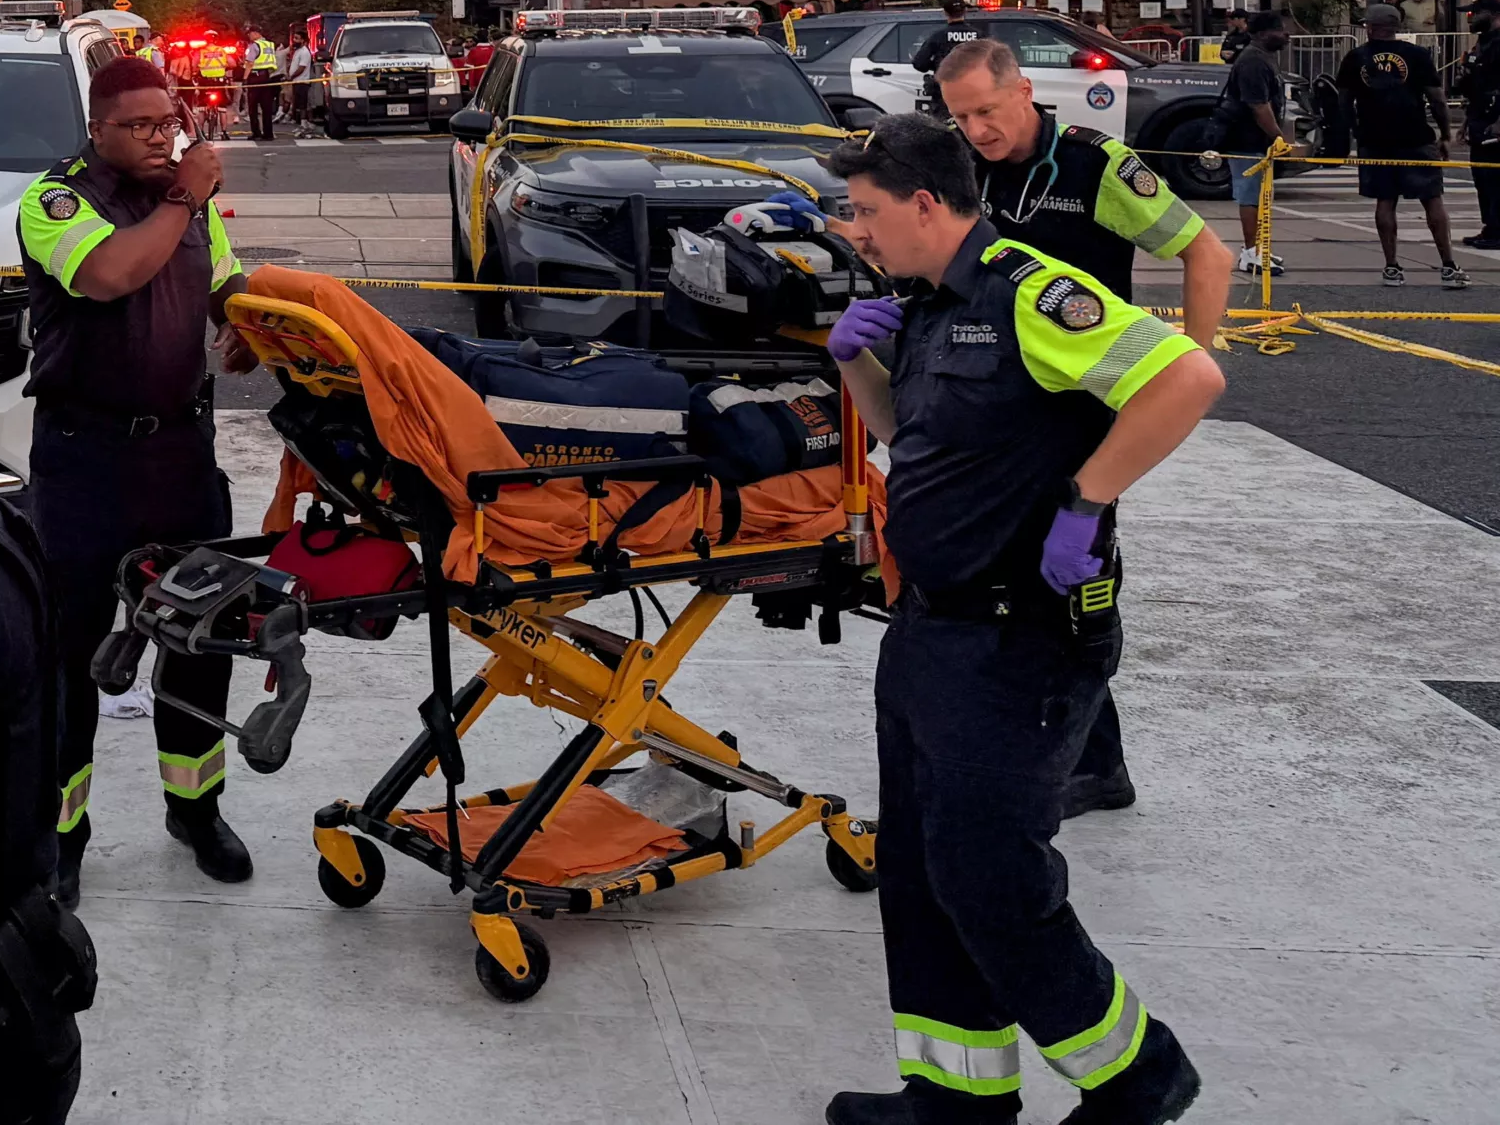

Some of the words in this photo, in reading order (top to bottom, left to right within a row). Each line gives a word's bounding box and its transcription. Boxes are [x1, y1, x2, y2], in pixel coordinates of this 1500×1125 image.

[947, 32, 977, 42] POLICE
[687, 285, 722, 304] Series
[534, 443, 614, 456] TORONTO
[805, 435, 827, 451] FIRST
[484, 605, 546, 649] tryker
